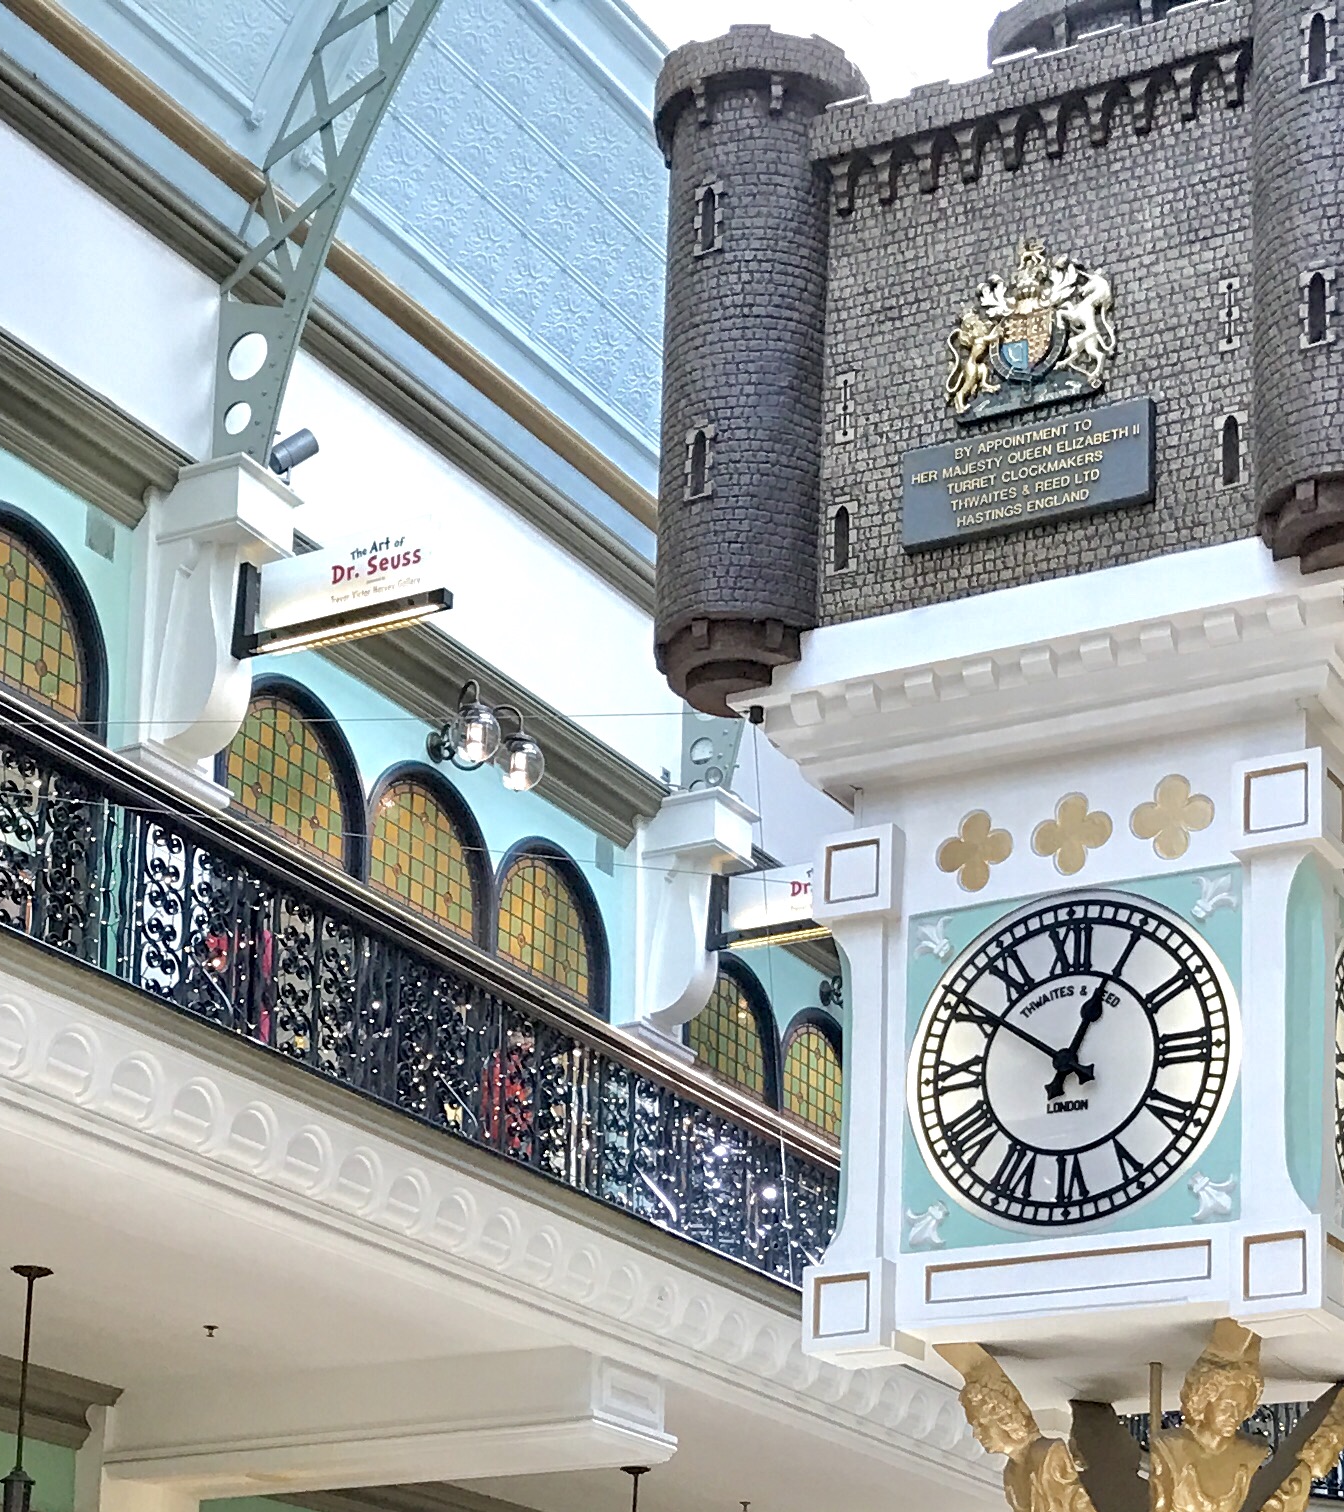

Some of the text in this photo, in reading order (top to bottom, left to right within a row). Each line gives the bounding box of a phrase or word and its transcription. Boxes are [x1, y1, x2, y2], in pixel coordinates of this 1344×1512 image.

[911, 424, 1140, 486] HER MAJESTY QUEEN ELIZABETH II
[954, 419, 1092, 460] BY APPOINTMENT TO
[947, 450, 1103, 495] TURRET CLOCKMAKERS
[951, 468, 1100, 512] THWAITES & REED LTD
[956, 489, 1090, 528] HASTINGS ENGLAND
[331, 548, 422, 585] Dr. Seuss
[350, 536, 406, 561] The Art of
[1020, 986, 1074, 1019] THWAITES
[1079, 986, 1087, 996] &
[1047, 1099, 1088, 1114] LONDON
